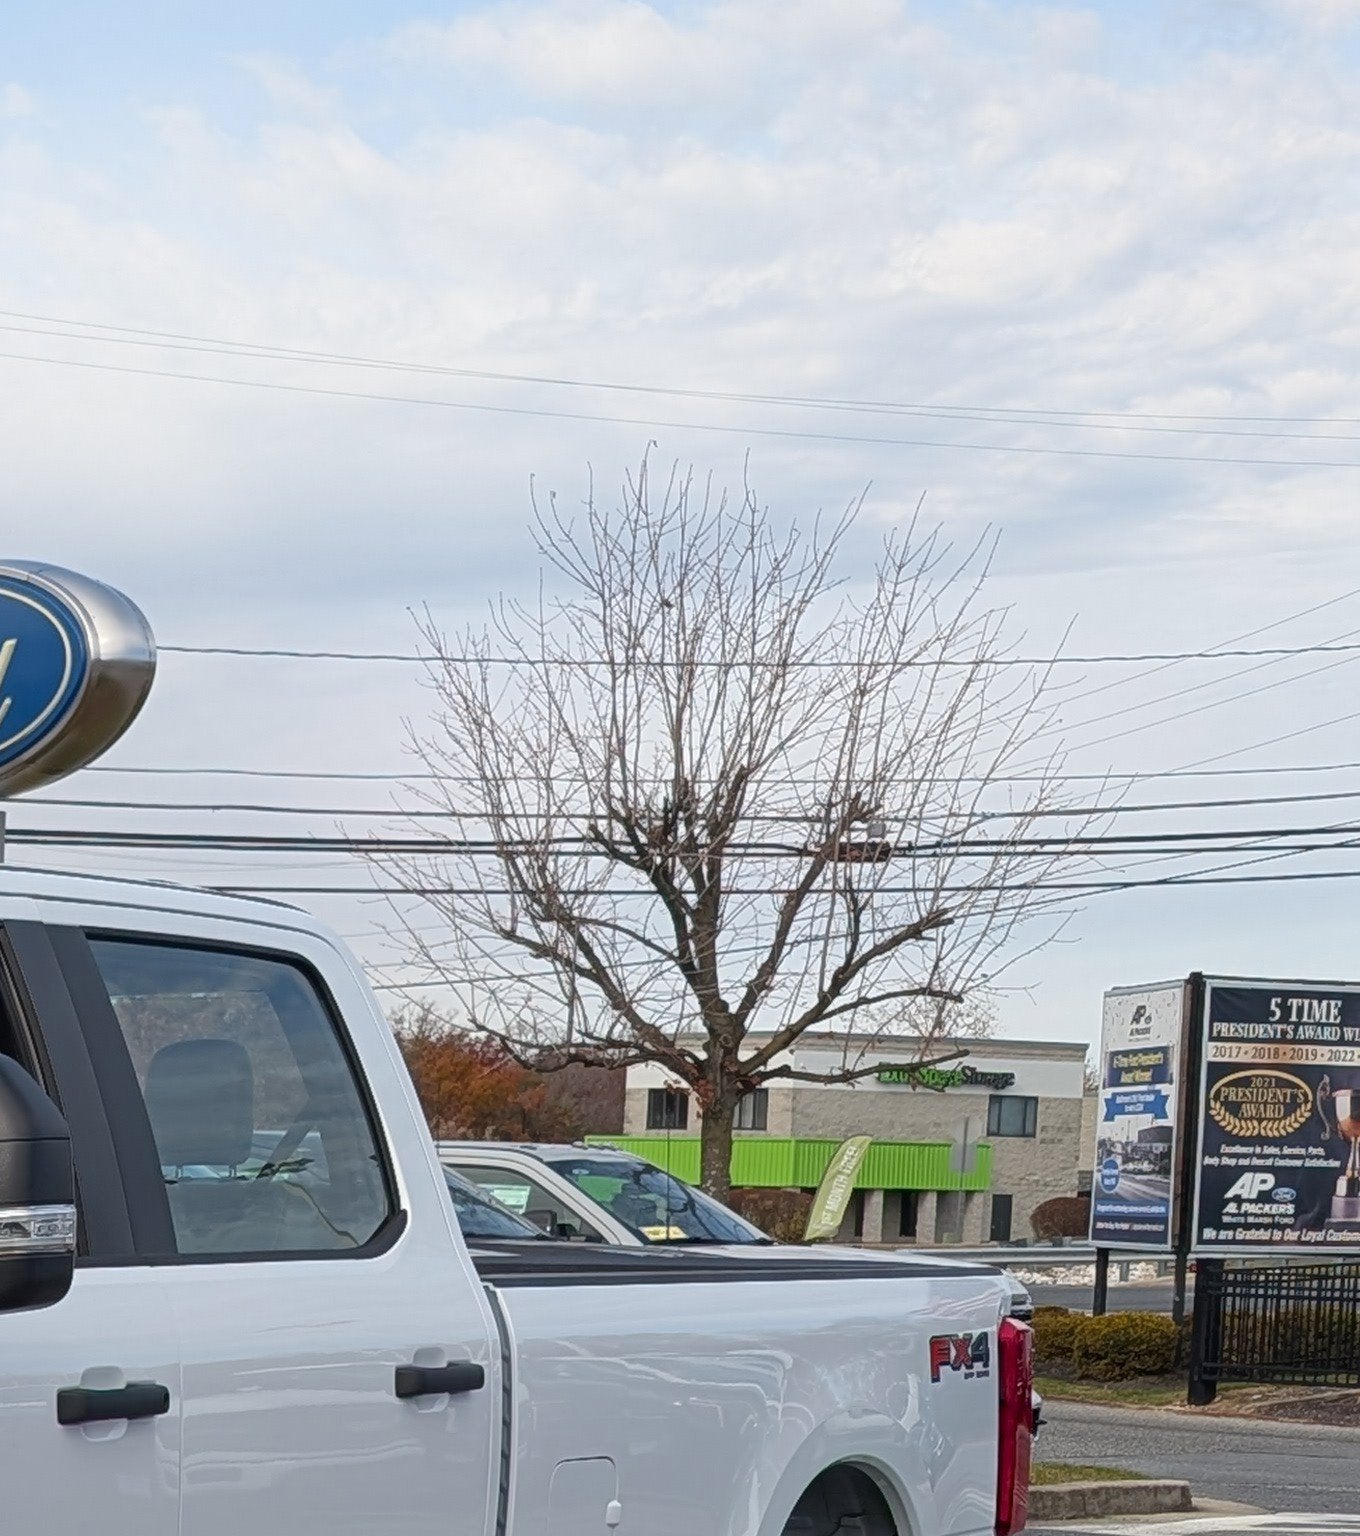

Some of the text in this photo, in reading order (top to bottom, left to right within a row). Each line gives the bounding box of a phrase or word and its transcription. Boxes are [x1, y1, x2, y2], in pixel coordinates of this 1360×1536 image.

[1268, 997, 1342, 1023] 5 TIME
[1212, 1022, 1294, 1039] PRESIDENT'S
[1296, 1025, 1340, 1041] AWARD
[1212, 1045, 1355, 1061] 2017 2018 2019 2022
[1220, 1087, 1304, 1103] PRESIDENT'S
[1238, 1103, 1284, 1118] AWARD
[1224, 1172, 1275, 1199] AP
[929, 1331, 990, 1383] FX4
